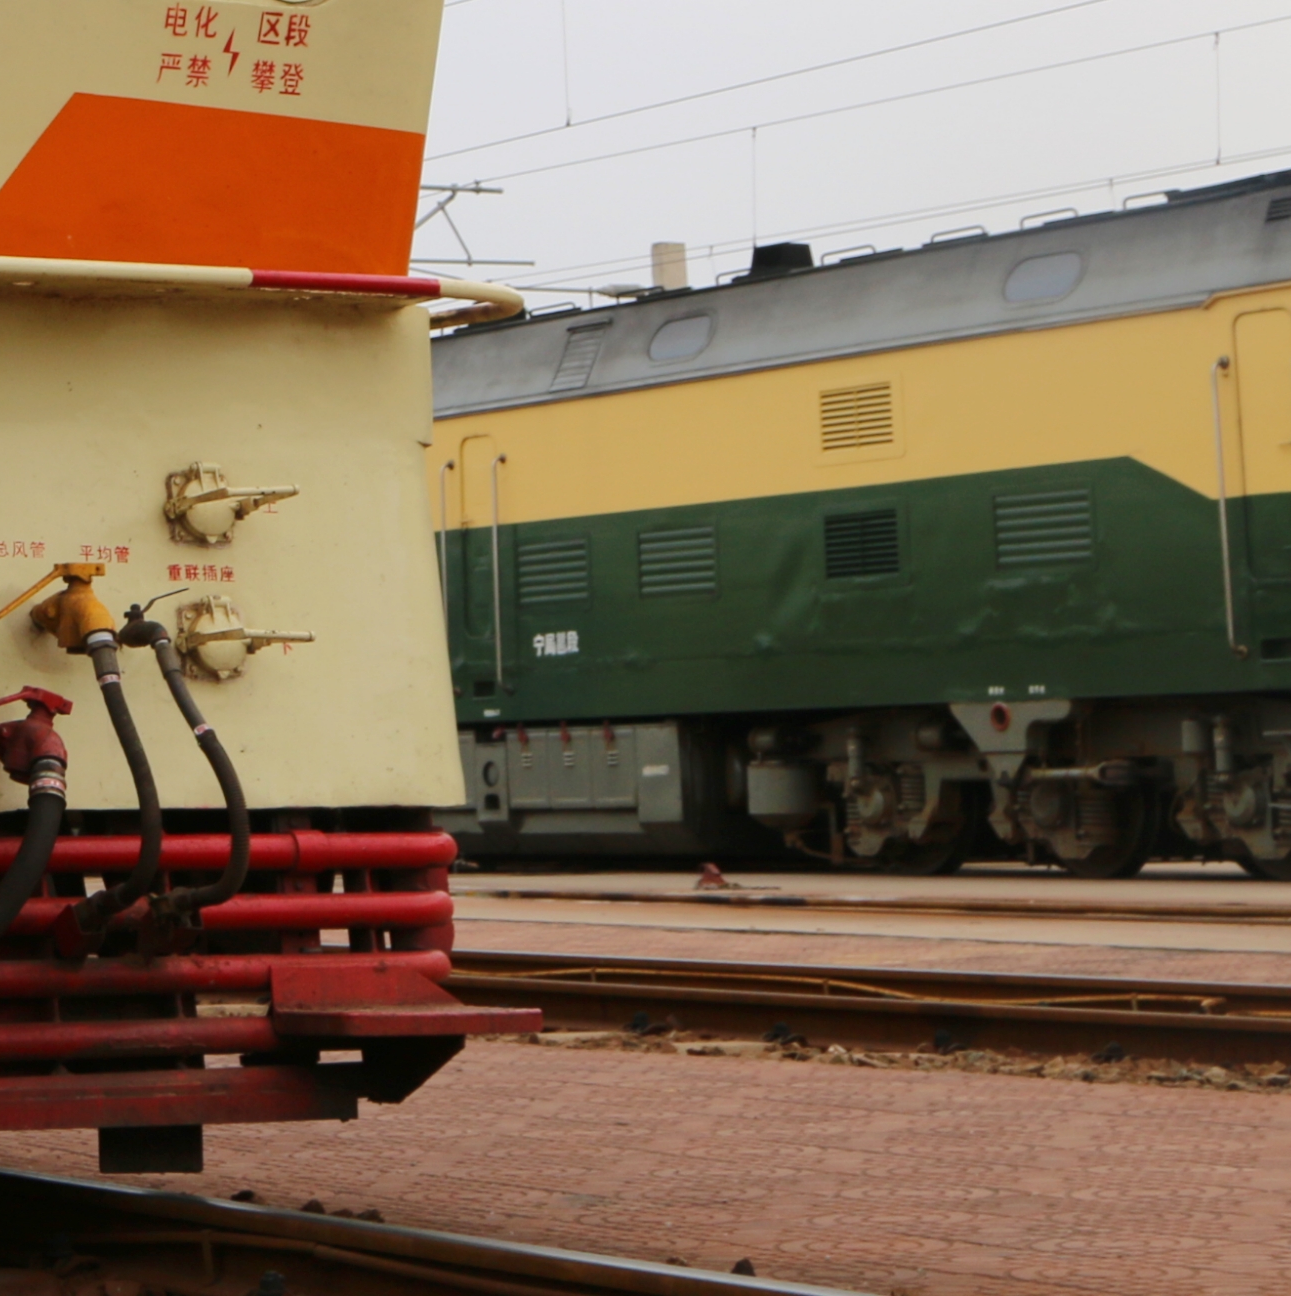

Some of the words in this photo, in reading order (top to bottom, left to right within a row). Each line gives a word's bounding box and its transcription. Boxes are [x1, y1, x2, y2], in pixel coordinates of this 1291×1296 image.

[164, 3, 219, 39] 电化
[257, 11, 312, 47] 区段
[156, 52, 212, 88] 严禁
[251, 60, 305, 96] 攀登
[79, 545, 131, 564] 平均管
[167, 564, 235, 582] 重联插座
